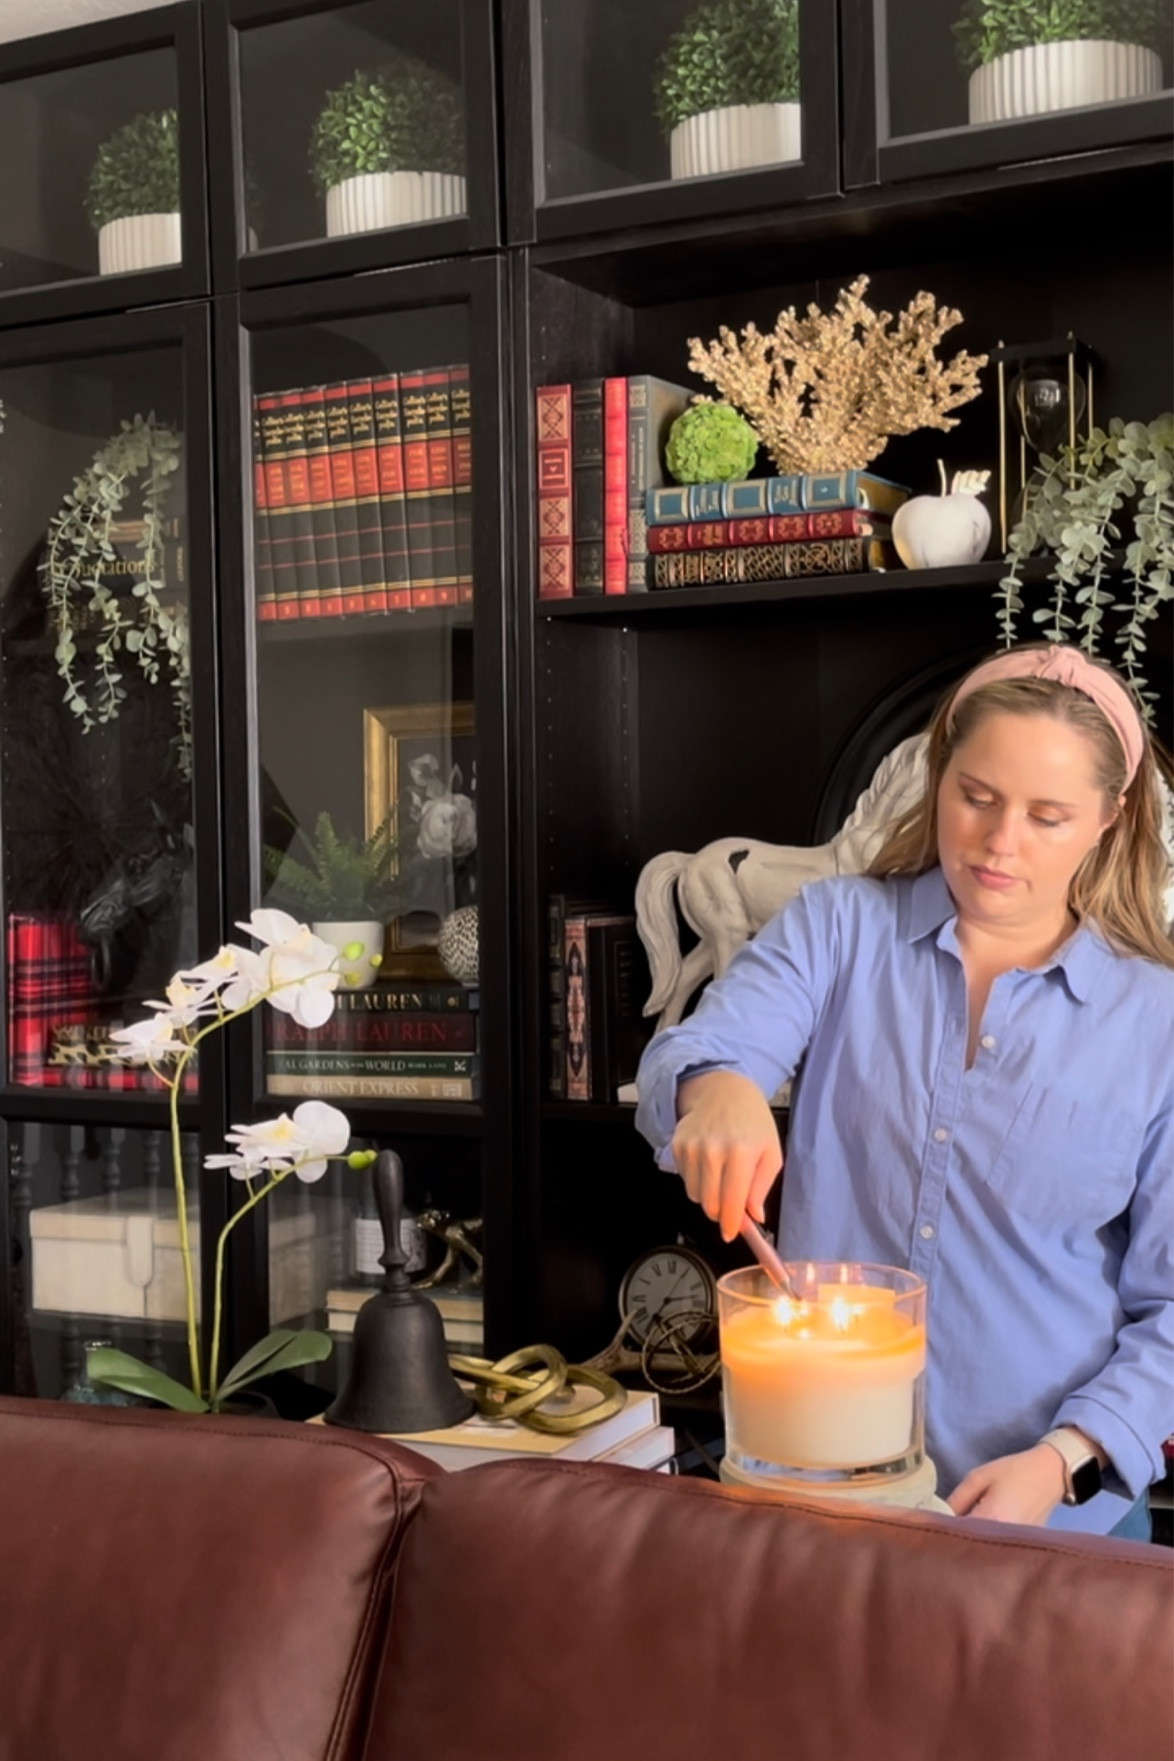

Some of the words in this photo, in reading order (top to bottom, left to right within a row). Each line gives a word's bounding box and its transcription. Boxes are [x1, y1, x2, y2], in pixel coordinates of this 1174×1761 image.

[73, 556, 155, 577] uoations
[351, 993, 423, 1010] LAUREN
[357, 1021, 448, 1042] LAUREN
[298, 1058, 350, 1071] GARDENS
[364, 1058, 406, 1072] WORLD
[302, 1079, 357, 1095] ORIENT
[362, 1080, 419, 1095] EXPRESS
